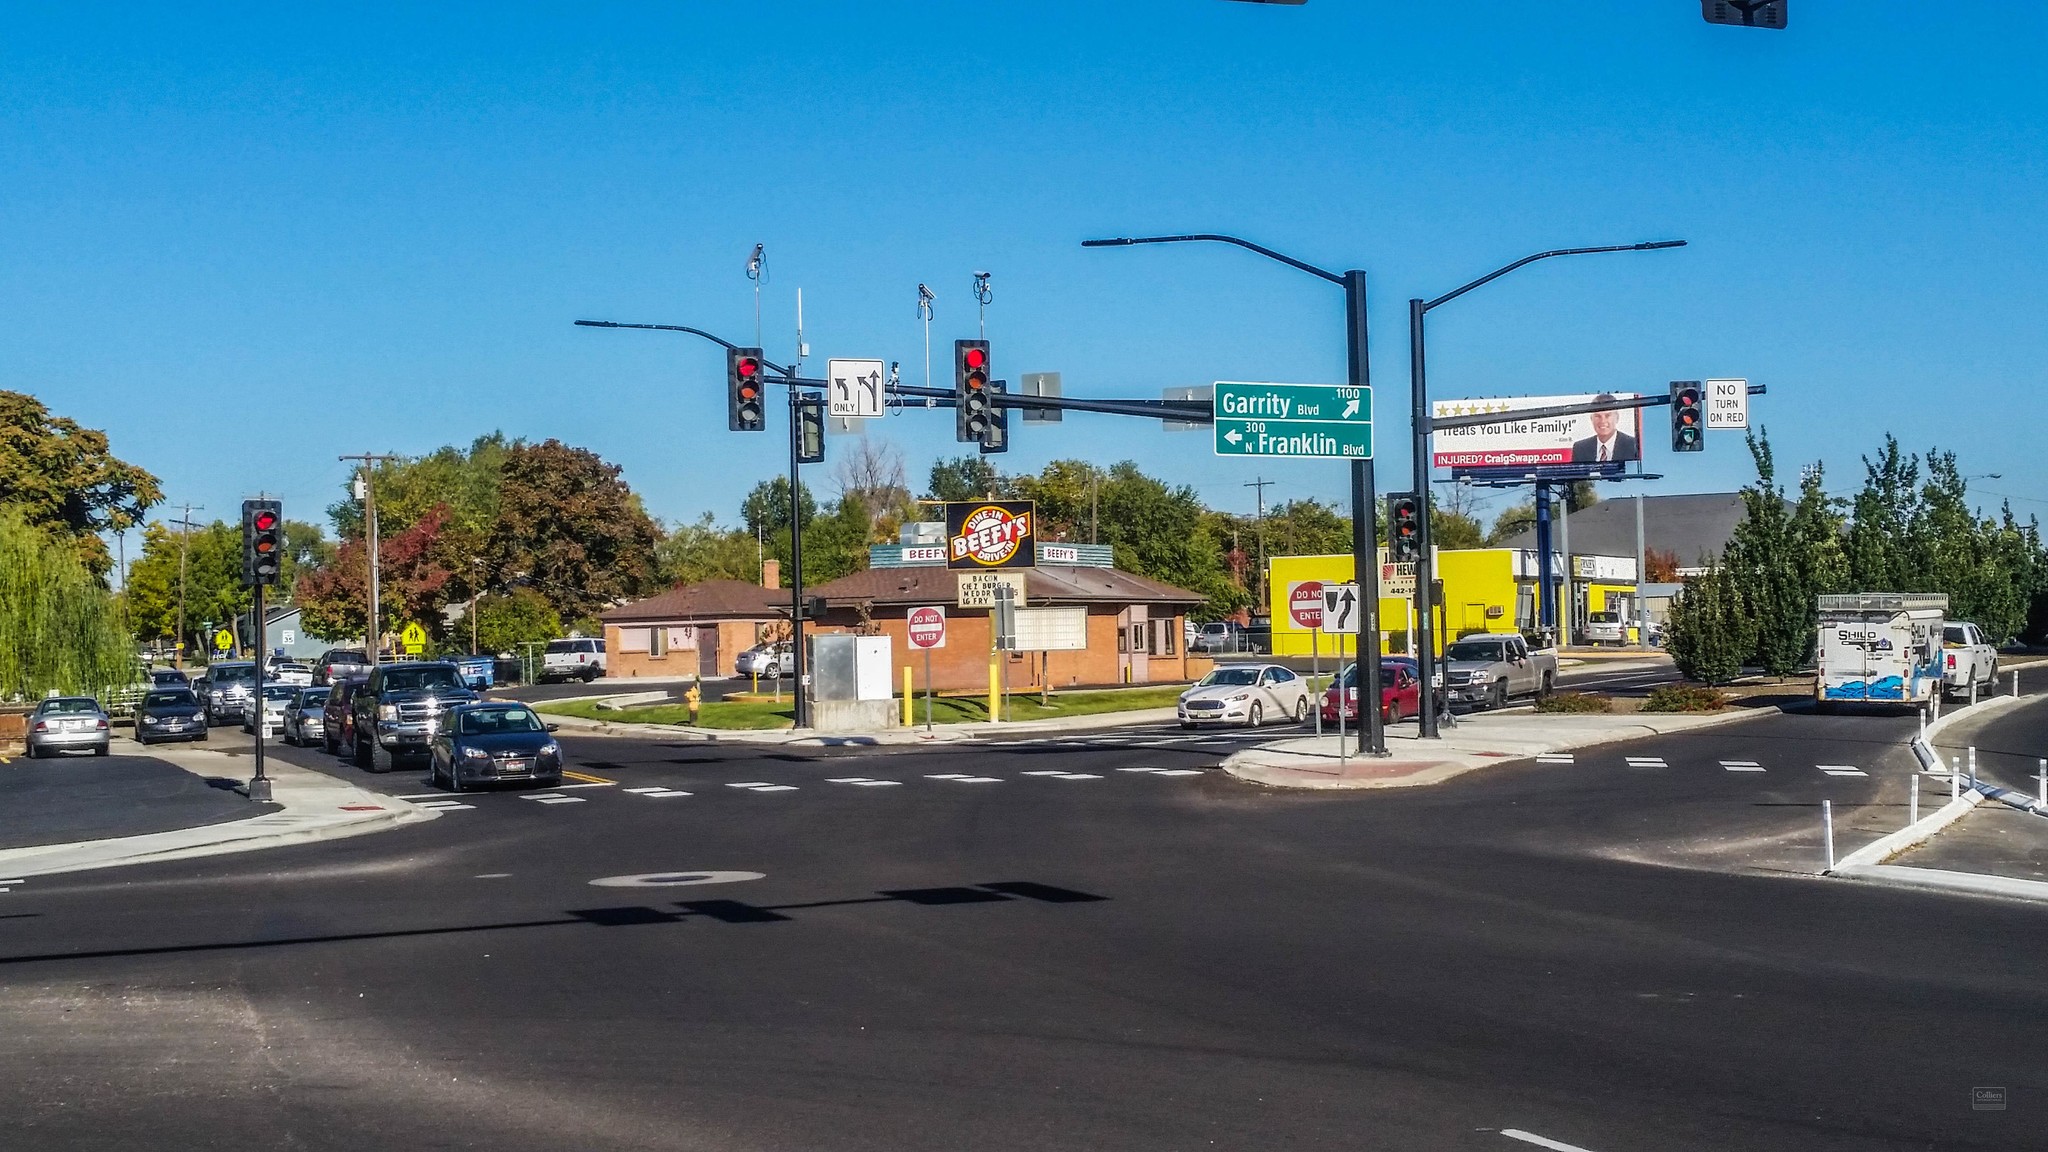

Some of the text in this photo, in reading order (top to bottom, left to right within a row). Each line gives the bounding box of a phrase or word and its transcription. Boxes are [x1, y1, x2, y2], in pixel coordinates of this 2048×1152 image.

[1335, 388, 1360, 399] 1100
[1717, 384, 1736, 395] NO
[834, 402, 855, 412] ONLY
[1223, 392, 1320, 419] Garrity Blvd
[1715, 400, 1738, 408] TURN
[1710, 412, 1744, 423] ON RED
[1245, 422, 1266, 433] 300
[1480, 424, 1501, 435] You
[1504, 421, 1527, 434] Like
[1245, 432, 1365, 456] N Franklin Blvd
[1438, 453, 1563, 465] INJURED? CraigSwapp.com
[967, 509, 1003, 529] DINE-IN
[953, 515, 1027, 557] BEEFY'S
[977, 541, 1016, 562] DRIVE-IN
[1046, 548, 1074, 560] BEEFY'S
[1296, 590, 1308, 599] DO
[914, 614, 938, 623] DO NOT
[1299, 611, 1323, 620] ENTE
[916, 633, 937, 641] ENTER
[1838, 630, 1877, 641] SHILO
